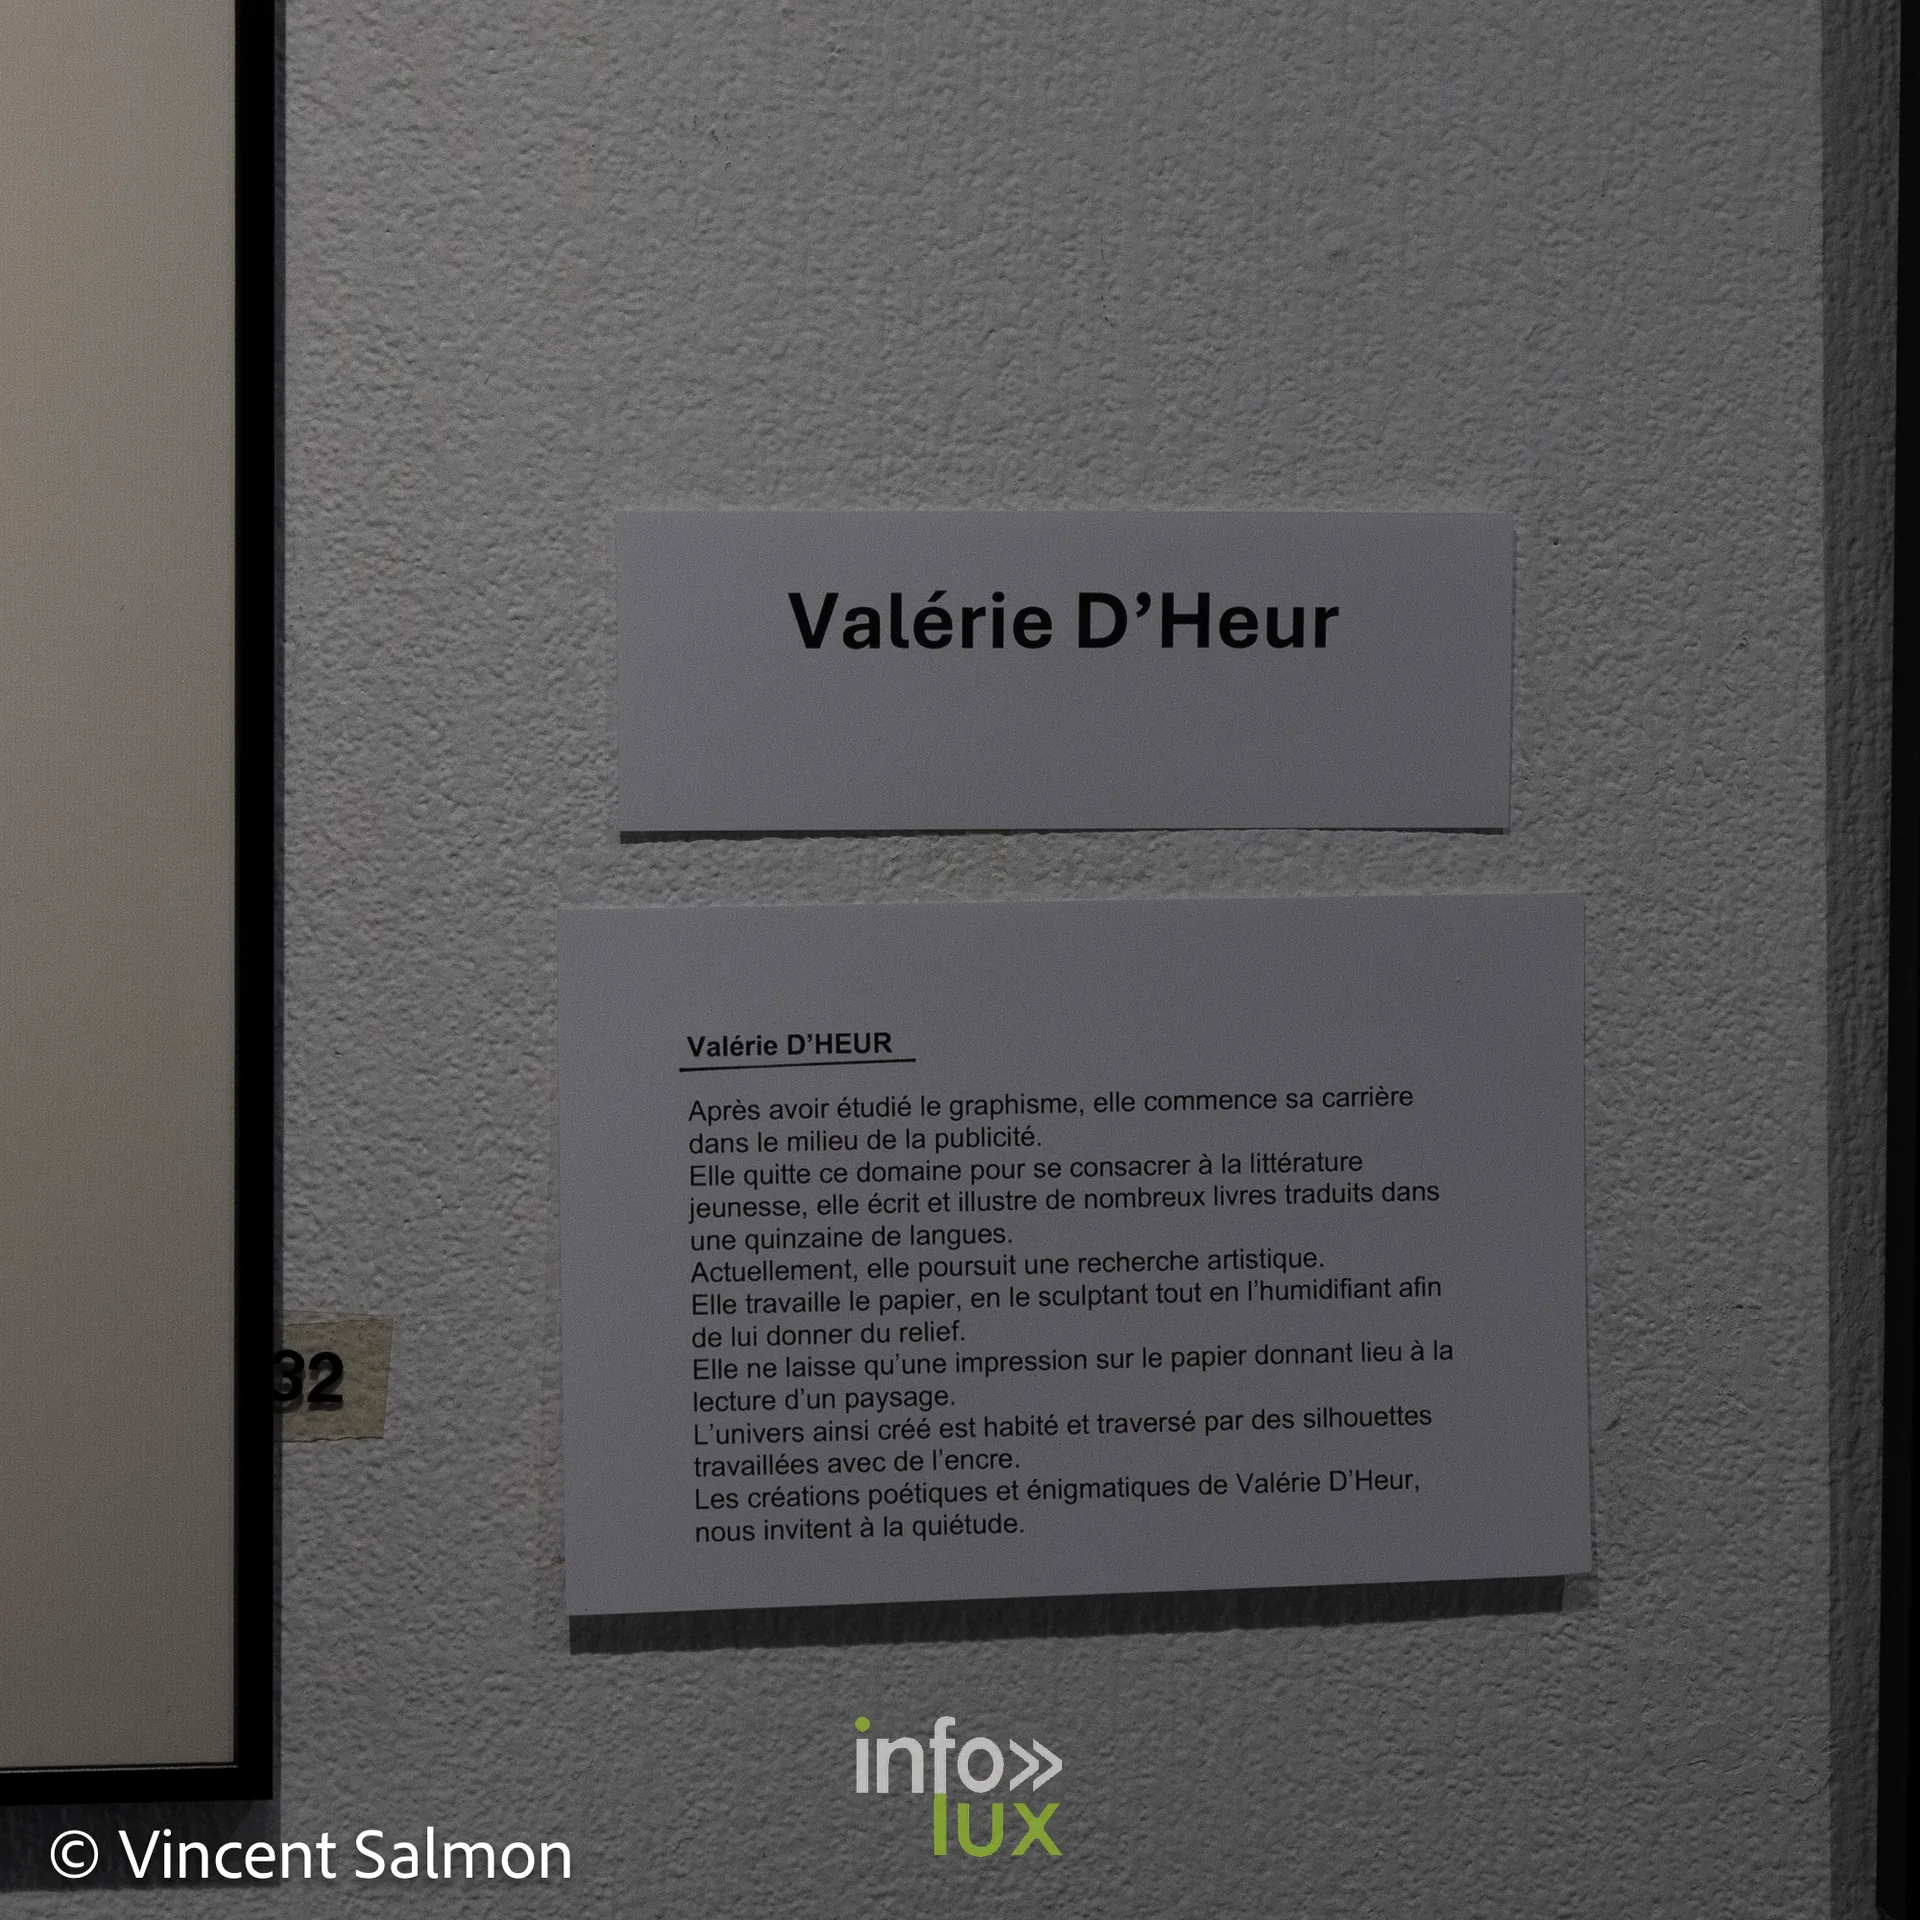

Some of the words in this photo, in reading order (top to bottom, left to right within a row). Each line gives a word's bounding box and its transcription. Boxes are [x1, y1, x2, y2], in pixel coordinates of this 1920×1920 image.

[787, 589, 1053, 650] Valérie
[1077, 591, 1340, 650] D’Heur
[686, 1034, 778, 1058] Valérie
[787, 1031, 893, 1056] D’HEUR
[688, 1098, 761, 1127] Après
[769, 1097, 830, 1120] avoir
[836, 1095, 912, 1119] étudié
[920, 1095, 941, 1117] le
[949, 1092, 1084, 1122] graphisme,
[1093, 1091, 1136, 1113] elle
[1143, 1092, 1278, 1112] commence
[1285, 1092, 1314, 1110] sa
[1322, 1085, 1414, 1109] carrière
[688, 1132, 749, 1155] dans
[757, 1131, 778, 1153] le
[787, 1129, 858, 1152] milieu
[866, 1128, 897, 1151] de
[905, 1128, 926, 1150] la
[935, 1124, 1042, 1155] publicité.
[690, 1164, 735, 1187] Elle
[743, 1163, 811, 1191] quitte
[819, 1166, 848, 1184] ce
[856, 1159, 962, 1183] domaine
[970, 1162, 1026, 1186] pour
[1033, 1161, 1062, 1179] se
[1069, 1159, 1191, 1178] consacrer
[1198, 1153, 1213, 1176] à
[1221, 1152, 1242, 1175] la
[1250, 1151, 1363, 1174] littérature
[688, 1199, 807, 1225] jeunesse,
[816, 1193, 860, 1216] elle
[867, 1191, 920, 1215] écrit
[927, 1192, 951, 1213] et
[958, 1190, 1037, 1212] illustre
[1045, 1188, 1076, 1211] de
[1084, 1186, 1206, 1210] nombreux
[1213, 1184, 1277, 1206] livres
[1284, 1181, 1374, 1205] traduits
[1381, 1181, 1440, 1203] dans
[690, 1233, 737, 1252] une
[744, 1226, 863, 1255] quinzaine
[871, 1225, 902, 1247] de
[910, 1224, 1013, 1251] langues.
[690, 1258, 858, 1284] Actuellement,
[867, 1256, 910, 1279] elle
[918, 1254, 1017, 1283] poursuit
[1024, 1257, 1070, 1276] une
[1078, 1250, 1199, 1274] recherche
[1207, 1247, 1324, 1274] artistique.
[692, 1293, 737, 1316] Elle
[745, 1291, 841, 1315] travaille
[849, 1290, 870, 1312] le
[879, 1288, 962, 1317] papier,
[970, 1291, 1001, 1309] en
[1009, 1286, 1031, 1308] le
[1038, 1283, 1149, 1311] sculptant
[1155, 1282, 1202, 1304] tout
[1209, 1285, 1239, 1303] en
[1247, 1277, 1392, 1302] l’humidifiant
[1398, 1275, 1442, 1298] afin
[691, 1326, 723, 1349] de
[731, 1325, 758, 1348] lui
[766, 1324, 853, 1347] donner
[860, 1322, 891, 1344] du
[899, 1319, 965, 1343] relief.
[272, 1348, 344, 1403] 32
[693, 1358, 739, 1381] Elle
[747, 1361, 778, 1379] ne
[785, 1355, 856, 1378] laisse
[864, 1353, 947, 1381] qu’une
[955, 1349, 1088, 1378] impression
[1096, 1352, 1135, 1370] sur
[1142, 1346, 1163, 1369] le
[1171, 1344, 1248, 1373] papier
[1254, 1342, 1353, 1366] donnant
[1361, 1340, 1402, 1363] lieu
[1410, 1339, 1425, 1362] à
[1433, 1339, 1454, 1361] la
[693, 1391, 776, 1413] lecture
[784, 1387, 836, 1411] d’un
[845, 1389, 955, 1414] paysage.
[694, 1422, 805, 1446] L’univers
[812, 1419, 869, 1443] ainsi
[877, 1417, 931, 1441] créé
[939, 1417, 977, 1439] est
[984, 1413, 1059, 1438] habité
[1066, 1414, 1090, 1436] et
[1096, 1409, 1196, 1435] traversé
[1204, 1414, 1245, 1437] par
[1251, 1408, 1295, 1431] des
[1303, 1405, 1433, 1429] silhouettes
[693, 1453, 819, 1478] travaillées
[827, 1455, 886, 1474] avec
[893, 1450, 924, 1473] de
[932, 1448, 1020, 1471] l’encre.
[695, 1488, 739, 1510] Les
[747, 1485, 860, 1509] créations
[868, 1481, 988, 1511] poétiques
[996, 1479, 1020, 1502] et
[1026, 1476, 1191, 1506] énigmatiques
[1198, 1473, 1228, 1496] de
[1235, 1471, 1321, 1495] Valérie
[1329, 1469, 1420, 1493] D’Heur,
[695, 1524, 756, 1543] nous
[764, 1517, 852, 1541] invitent
[859, 1515, 874, 1539] à
[883, 1515, 904, 1538] la
[912, 1512, 1024, 1542] quiétude.
